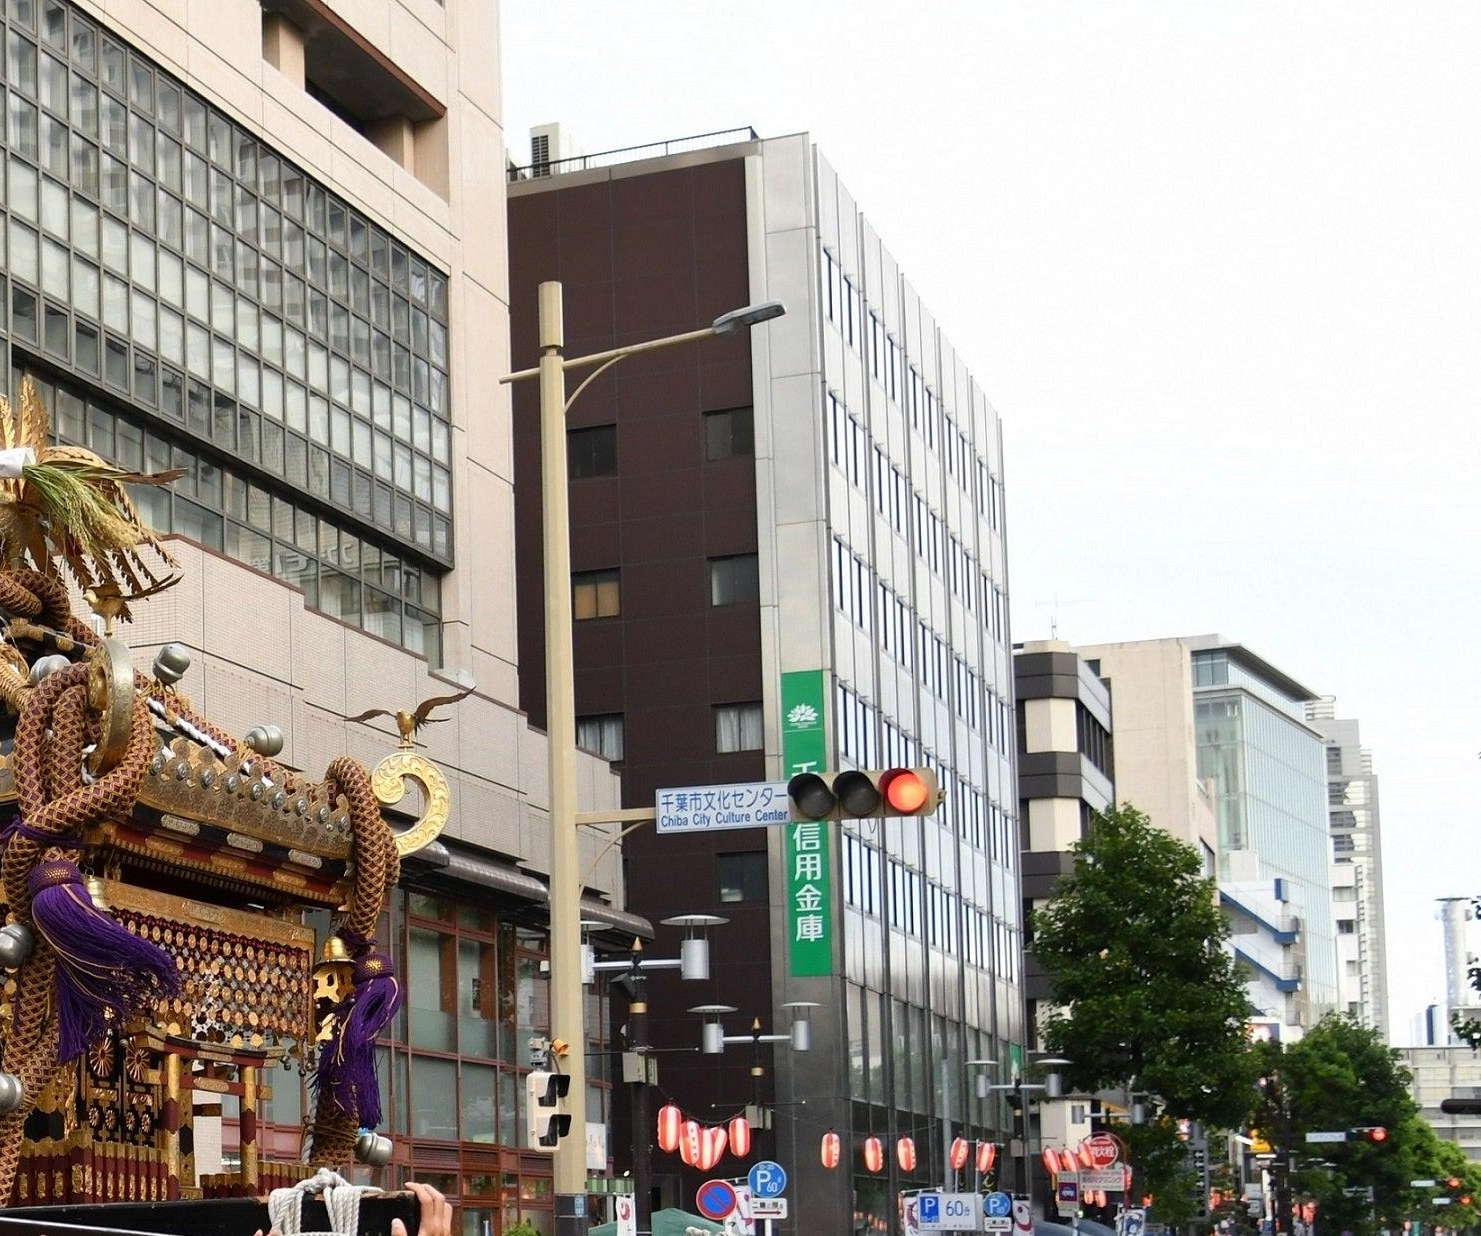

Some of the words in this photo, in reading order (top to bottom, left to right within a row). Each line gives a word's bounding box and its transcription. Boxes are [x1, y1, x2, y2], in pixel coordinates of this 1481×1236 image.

[661, 788, 788, 813] 千葉市文化センター
[661, 815, 688, 827] Chiba
[693, 813, 711, 827] City
[716, 811, 751, 823] Culture
[755, 810, 788, 822] Center
[757, 1170, 771, 1193] P
[925, 1198, 936, 1214] P
